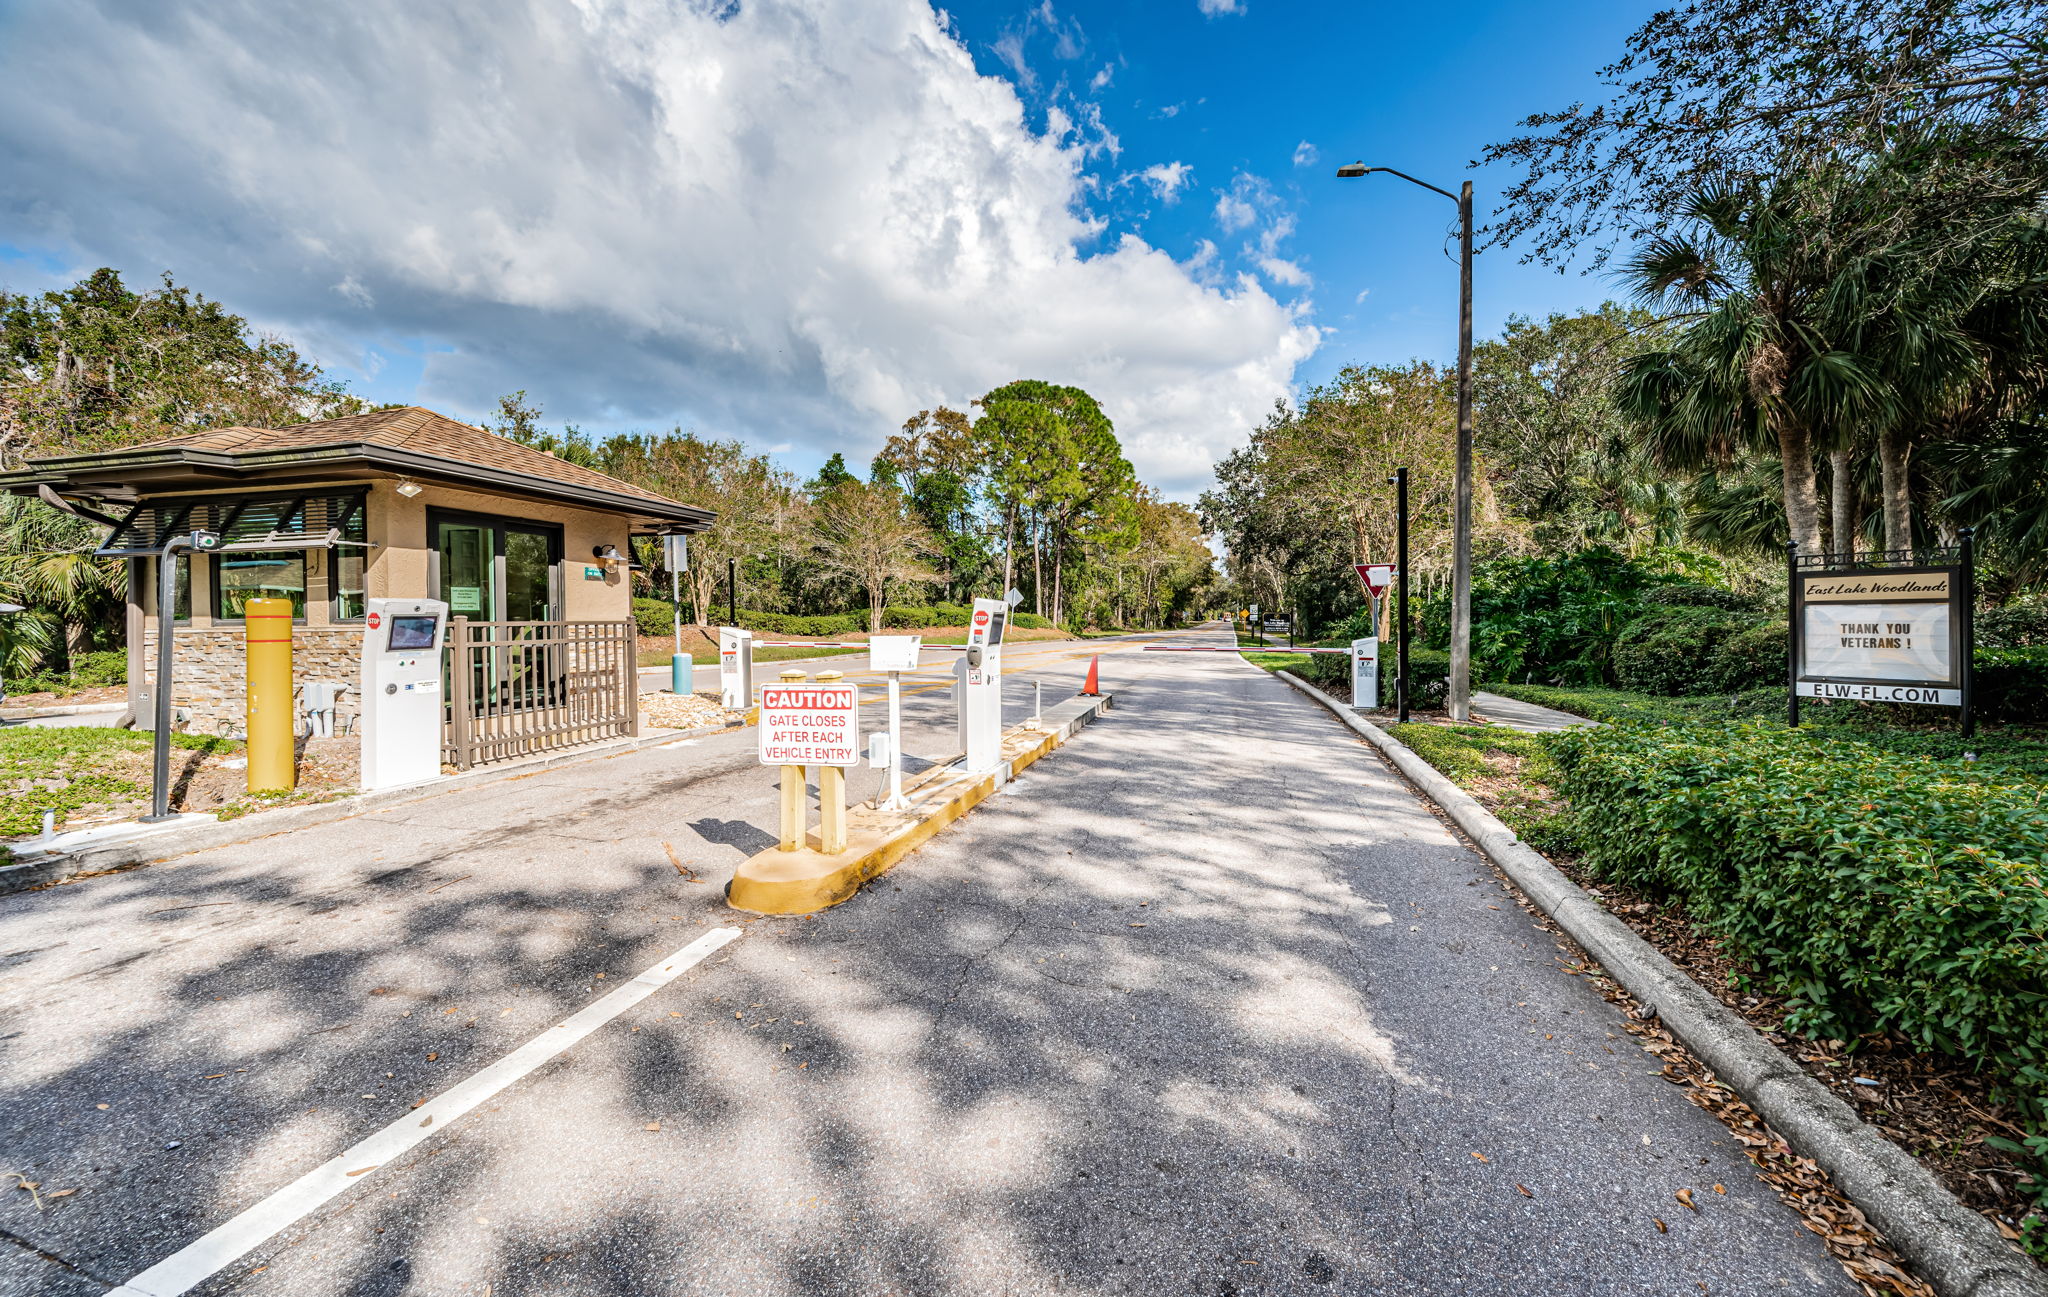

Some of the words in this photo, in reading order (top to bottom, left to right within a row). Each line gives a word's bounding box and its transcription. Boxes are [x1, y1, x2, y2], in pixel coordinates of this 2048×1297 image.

[1806, 584, 1834, 595] East
[1836, 583, 1867, 594] Lake
[1869, 580, 1947, 594] Woodlands
[368, 617, 380, 625] STOP
[1840, 623, 1879, 635] THANK
[1886, 623, 1911, 635] YOU
[1841, 637, 1901, 649] VETERANS
[1813, 683, 1940, 703] ELW-FL.COM
[765, 692, 851, 708] CAUTION
[769, 715, 799, 726] GATE
[801, 715, 846, 727] CLOSES
[773, 731, 809, 743] AFTER
[812, 731, 843, 743] EACH
[765, 747, 812, 759] VEHICLE
[815, 748, 852, 759] ENTRY
